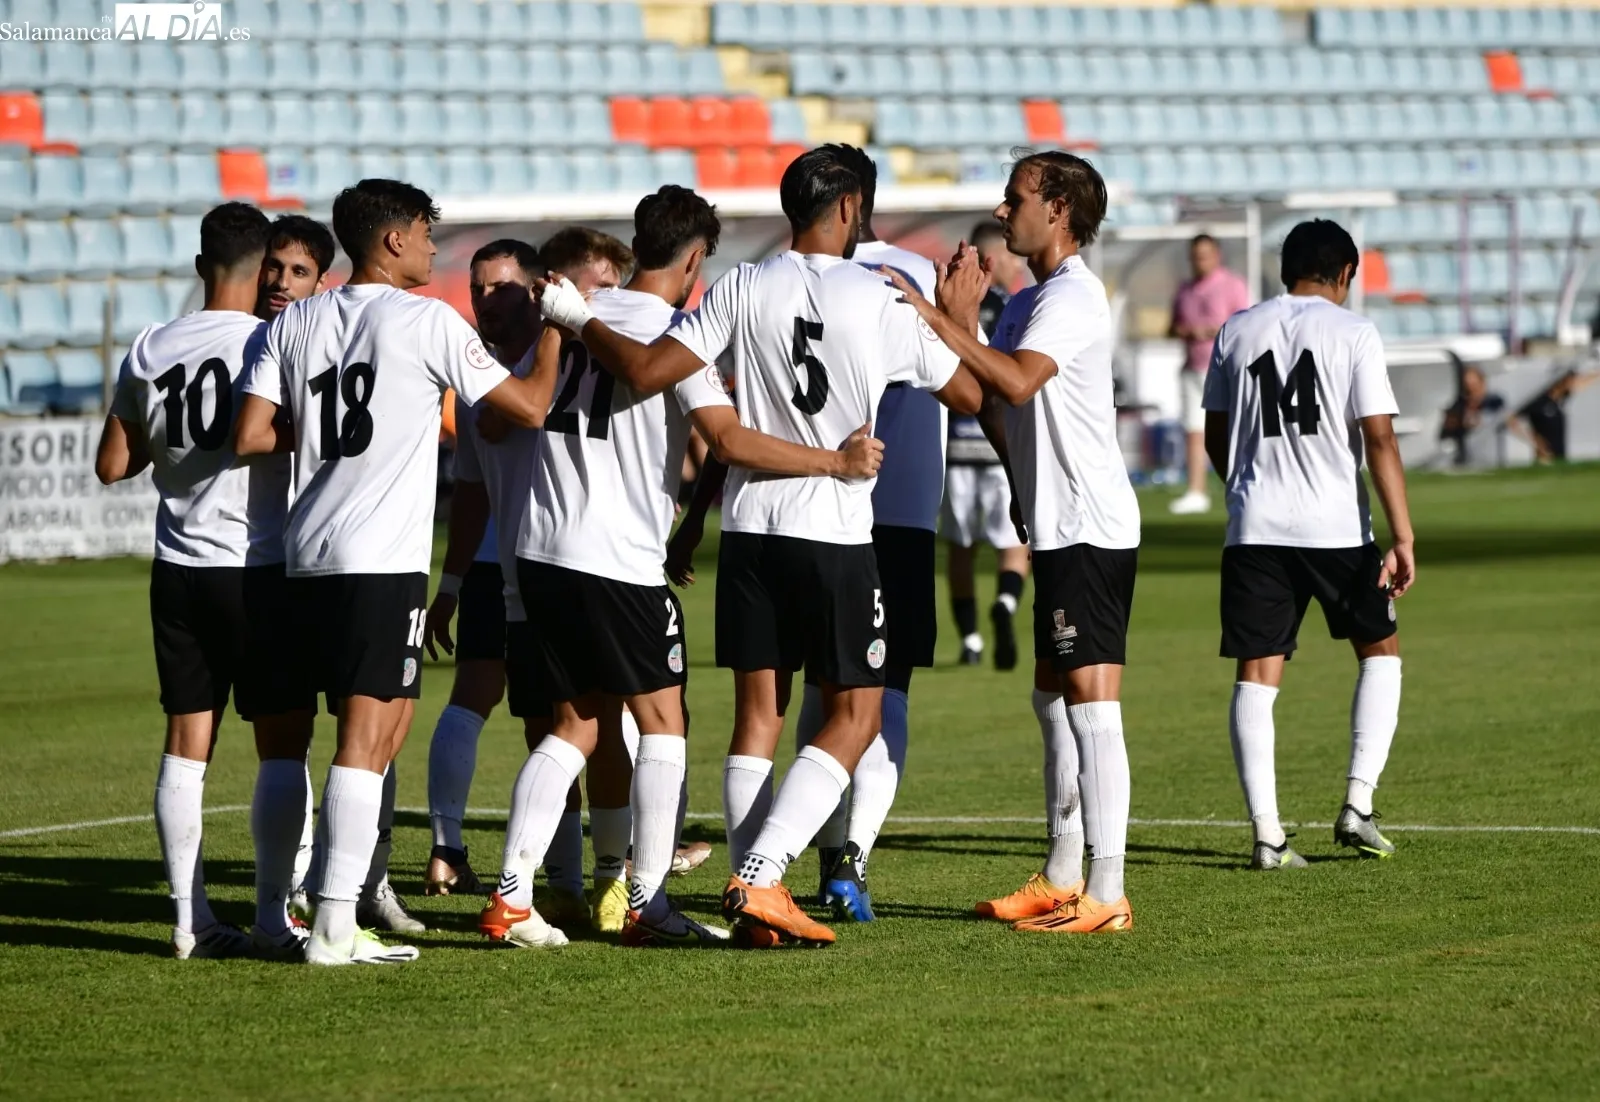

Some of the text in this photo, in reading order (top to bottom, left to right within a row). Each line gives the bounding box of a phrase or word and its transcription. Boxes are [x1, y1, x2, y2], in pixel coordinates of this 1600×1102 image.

[153, 357, 233, 450] 10
[308, 362, 374, 460] 18
[544, 340, 615, 440] 21
[791, 316, 829, 415] 5
[1247, 348, 1320, 438] 14
[0, 504, 82, 532] ABORAL
[407, 607, 426, 648] 18
[873, 588, 884, 628] 5
